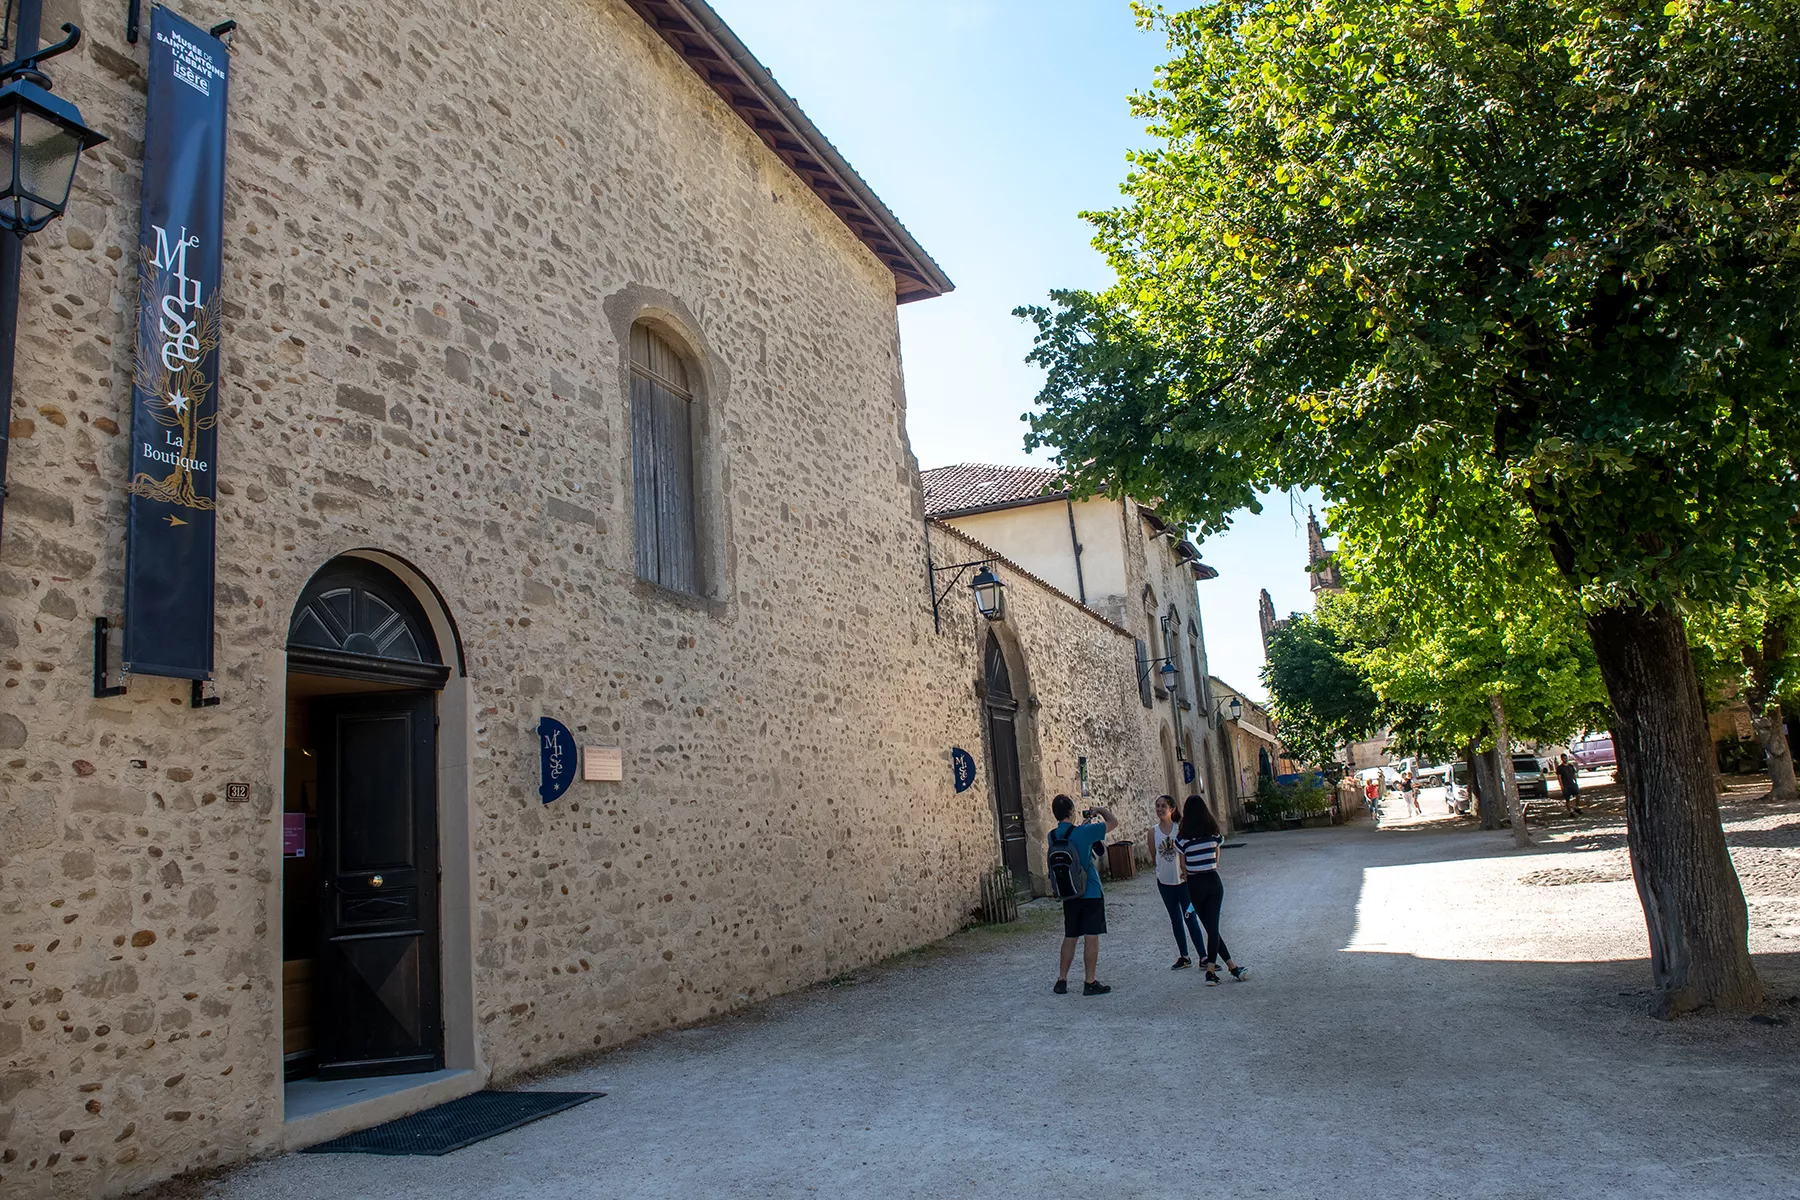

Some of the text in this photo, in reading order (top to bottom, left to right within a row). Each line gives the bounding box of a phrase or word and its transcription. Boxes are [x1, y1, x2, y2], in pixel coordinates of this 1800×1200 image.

[156, 32, 225, 80] SAINT-ANTOINE
[171, 47, 213, 79] L'ABBAYE
[203, 52, 213, 63] DE
[175, 60, 208, 90] isère
[180, 226, 200, 247] Le
[165, 430, 183, 447] La
[143, 443, 208, 472] Boutique
[231, 786, 246, 796] 312
